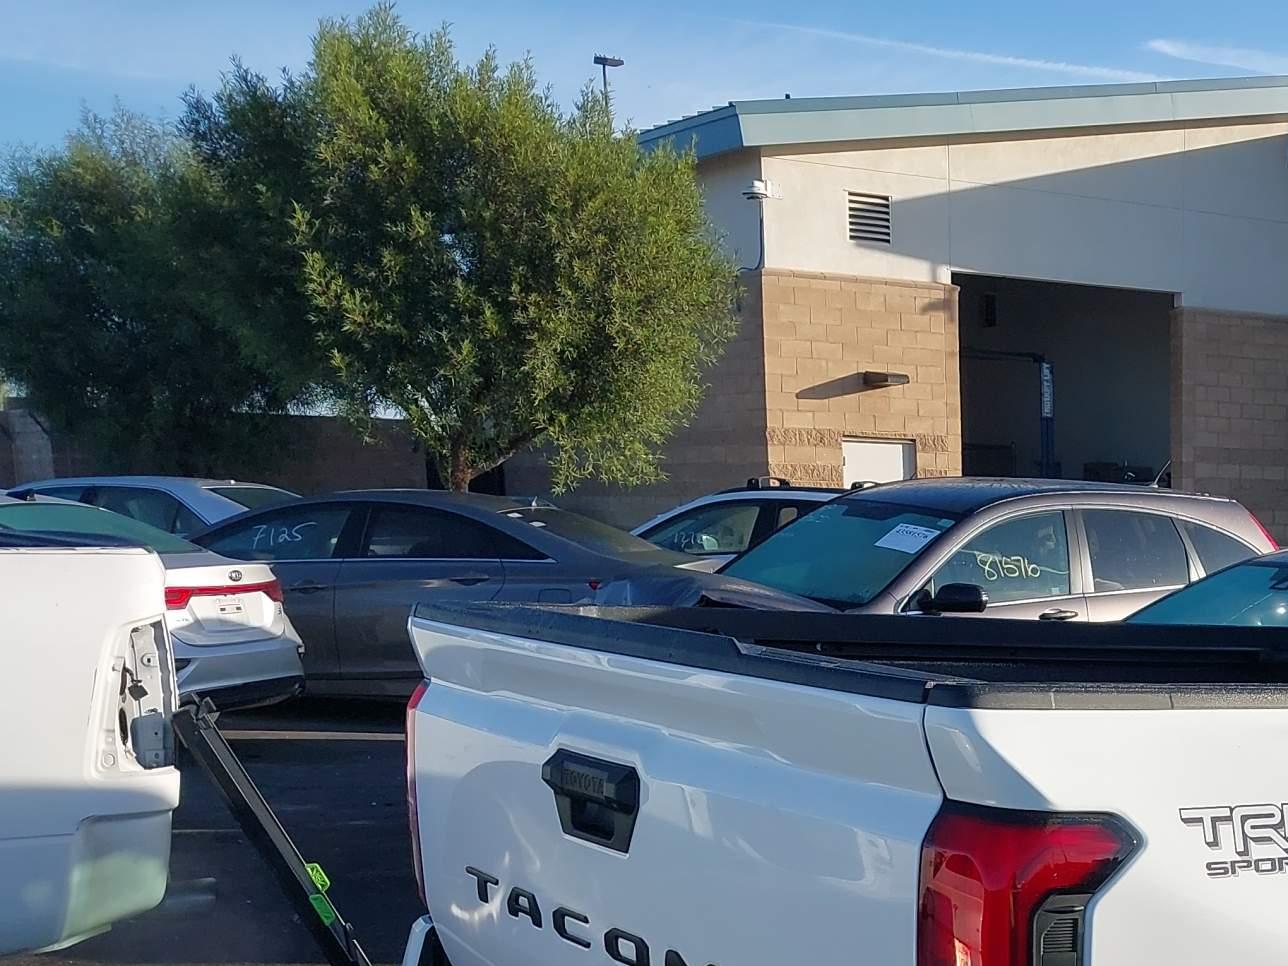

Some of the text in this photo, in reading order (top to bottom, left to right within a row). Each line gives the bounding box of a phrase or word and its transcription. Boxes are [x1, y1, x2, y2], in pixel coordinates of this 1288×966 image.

[252, 522, 318, 550] 7125
[976, 552, 1041, 581] 81576
[562, 768, 606, 795] TOYOTA
